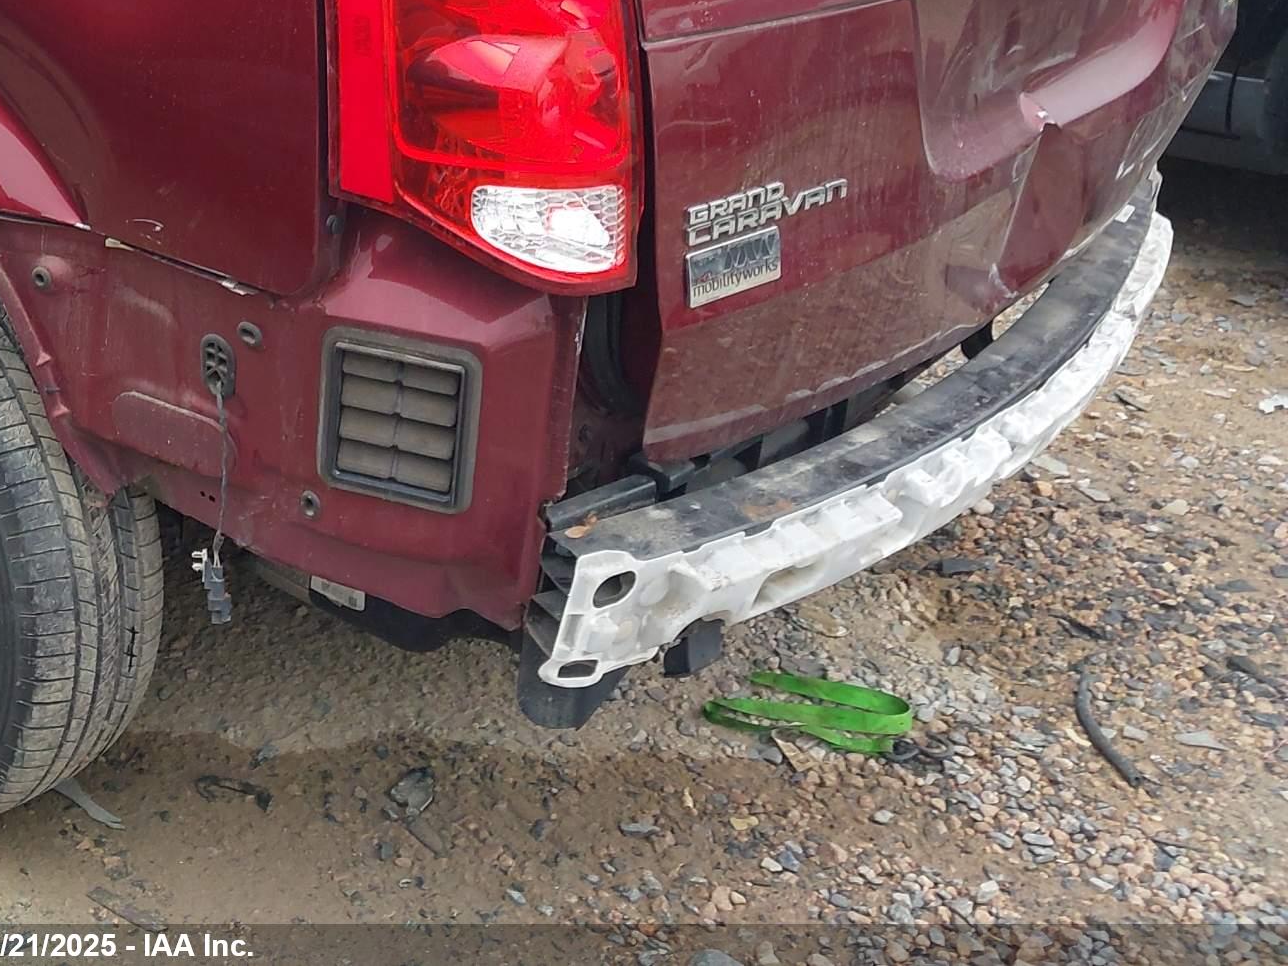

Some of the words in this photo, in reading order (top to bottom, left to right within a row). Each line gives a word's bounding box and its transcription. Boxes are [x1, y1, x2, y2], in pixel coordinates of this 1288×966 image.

[687, 181, 785, 226] GRAND
[688, 178, 848, 247] CARAVAN
[692, 257, 779, 299] mobilityworks
